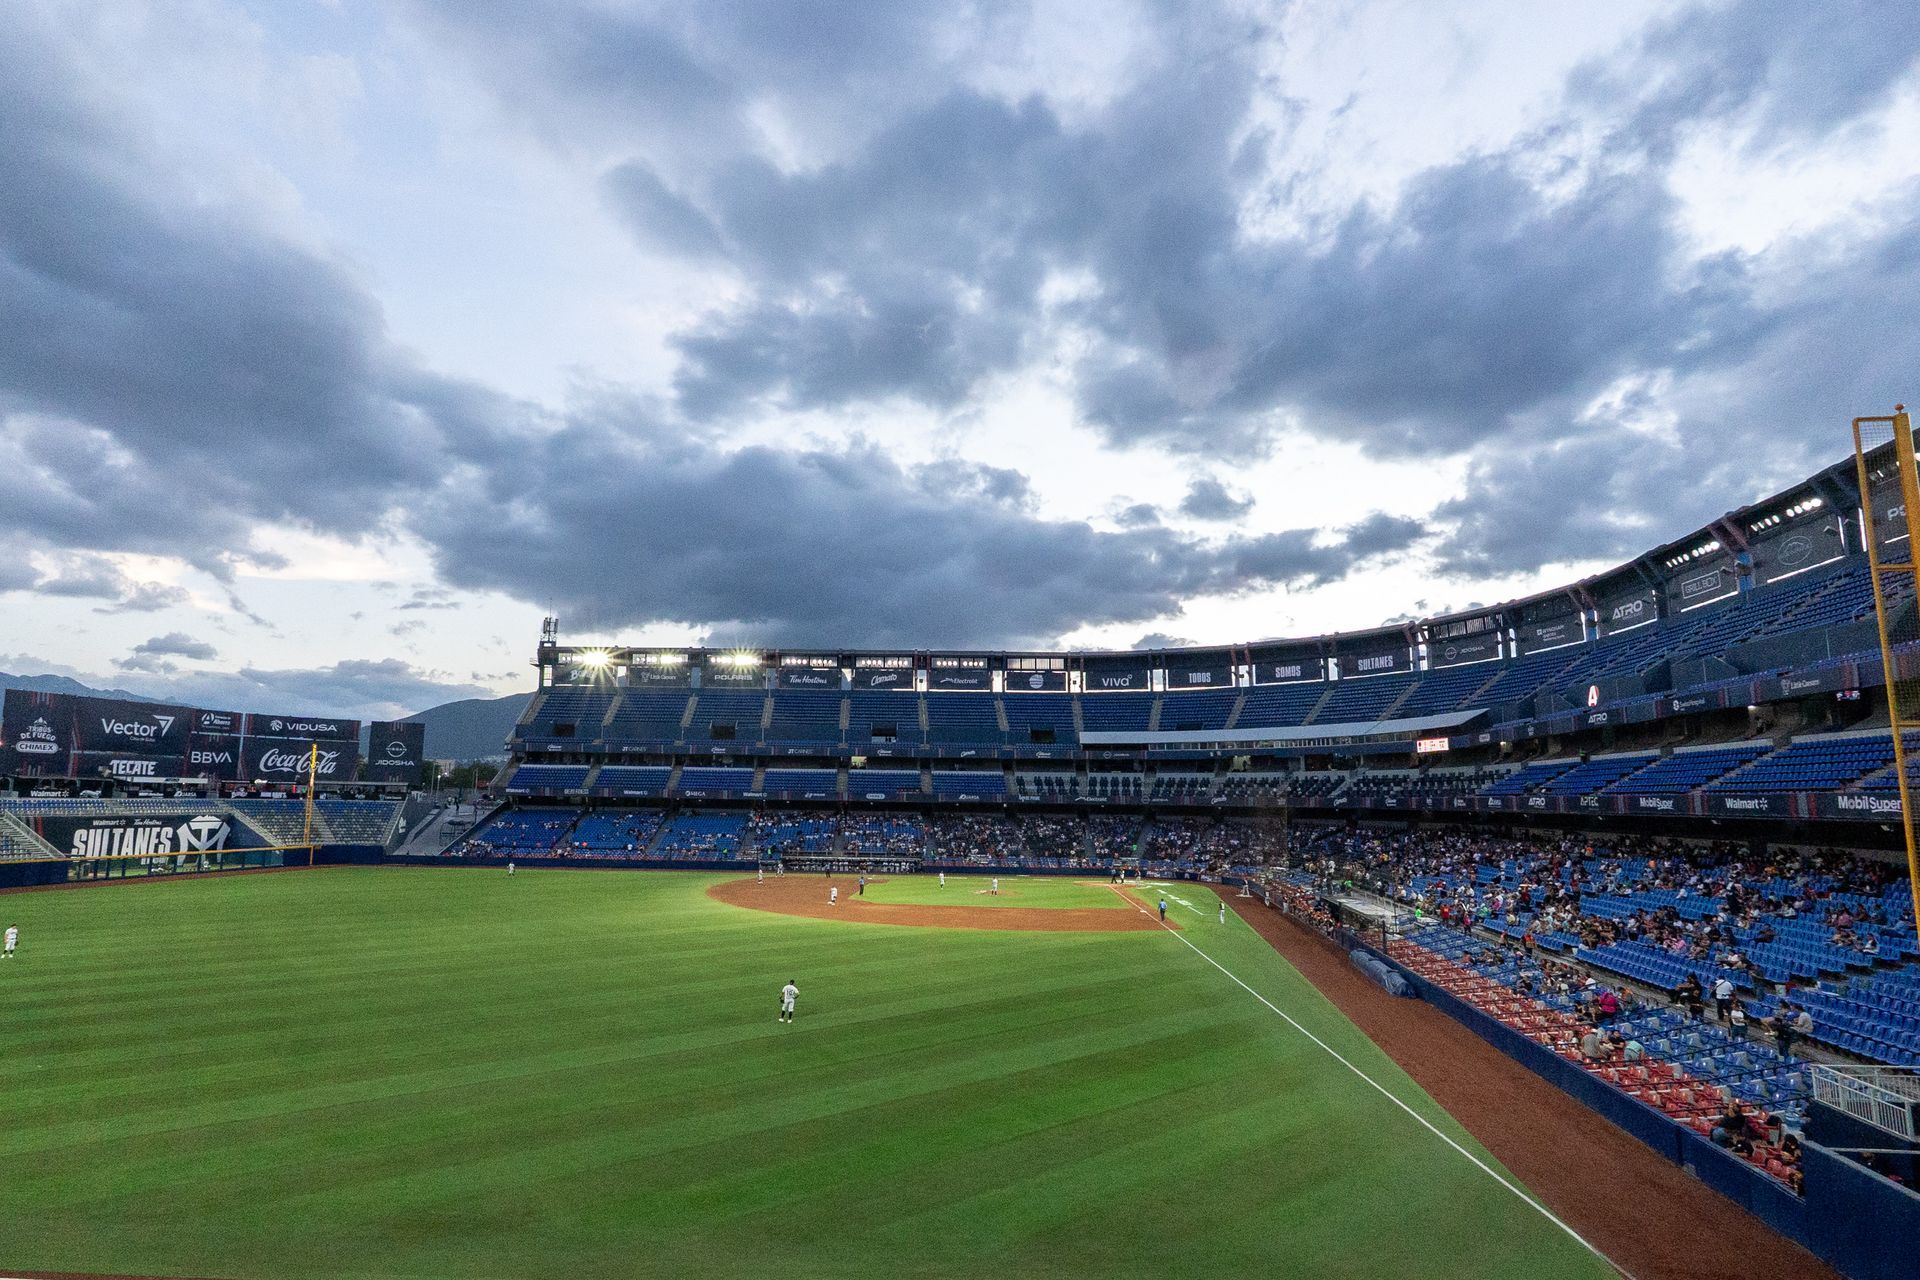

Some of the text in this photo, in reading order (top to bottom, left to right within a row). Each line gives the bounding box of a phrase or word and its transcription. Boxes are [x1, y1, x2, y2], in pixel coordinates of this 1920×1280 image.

[1612, 600, 1643, 620] ATRO
[1357, 655, 1394, 671] SULTANES
[1188, 672, 1212, 684] TODOS
[1275, 665, 1301, 678] SOMOS
[802, 675, 828, 684] Hortons
[871, 674, 898, 686] Clamato
[101, 718, 158, 737] Vector
[286, 722, 338, 732] VIDUSA
[20, 732, 56, 741] DE FUEGO
[20, 743, 54, 751] CHIMEX
[190, 751, 232, 764] BBVA
[259, 748, 341, 774] Coca-Cola
[109, 759, 159, 776] TECATE
[1725, 797, 1759, 809] Walmart
[71, 826, 174, 861] SULTANES
